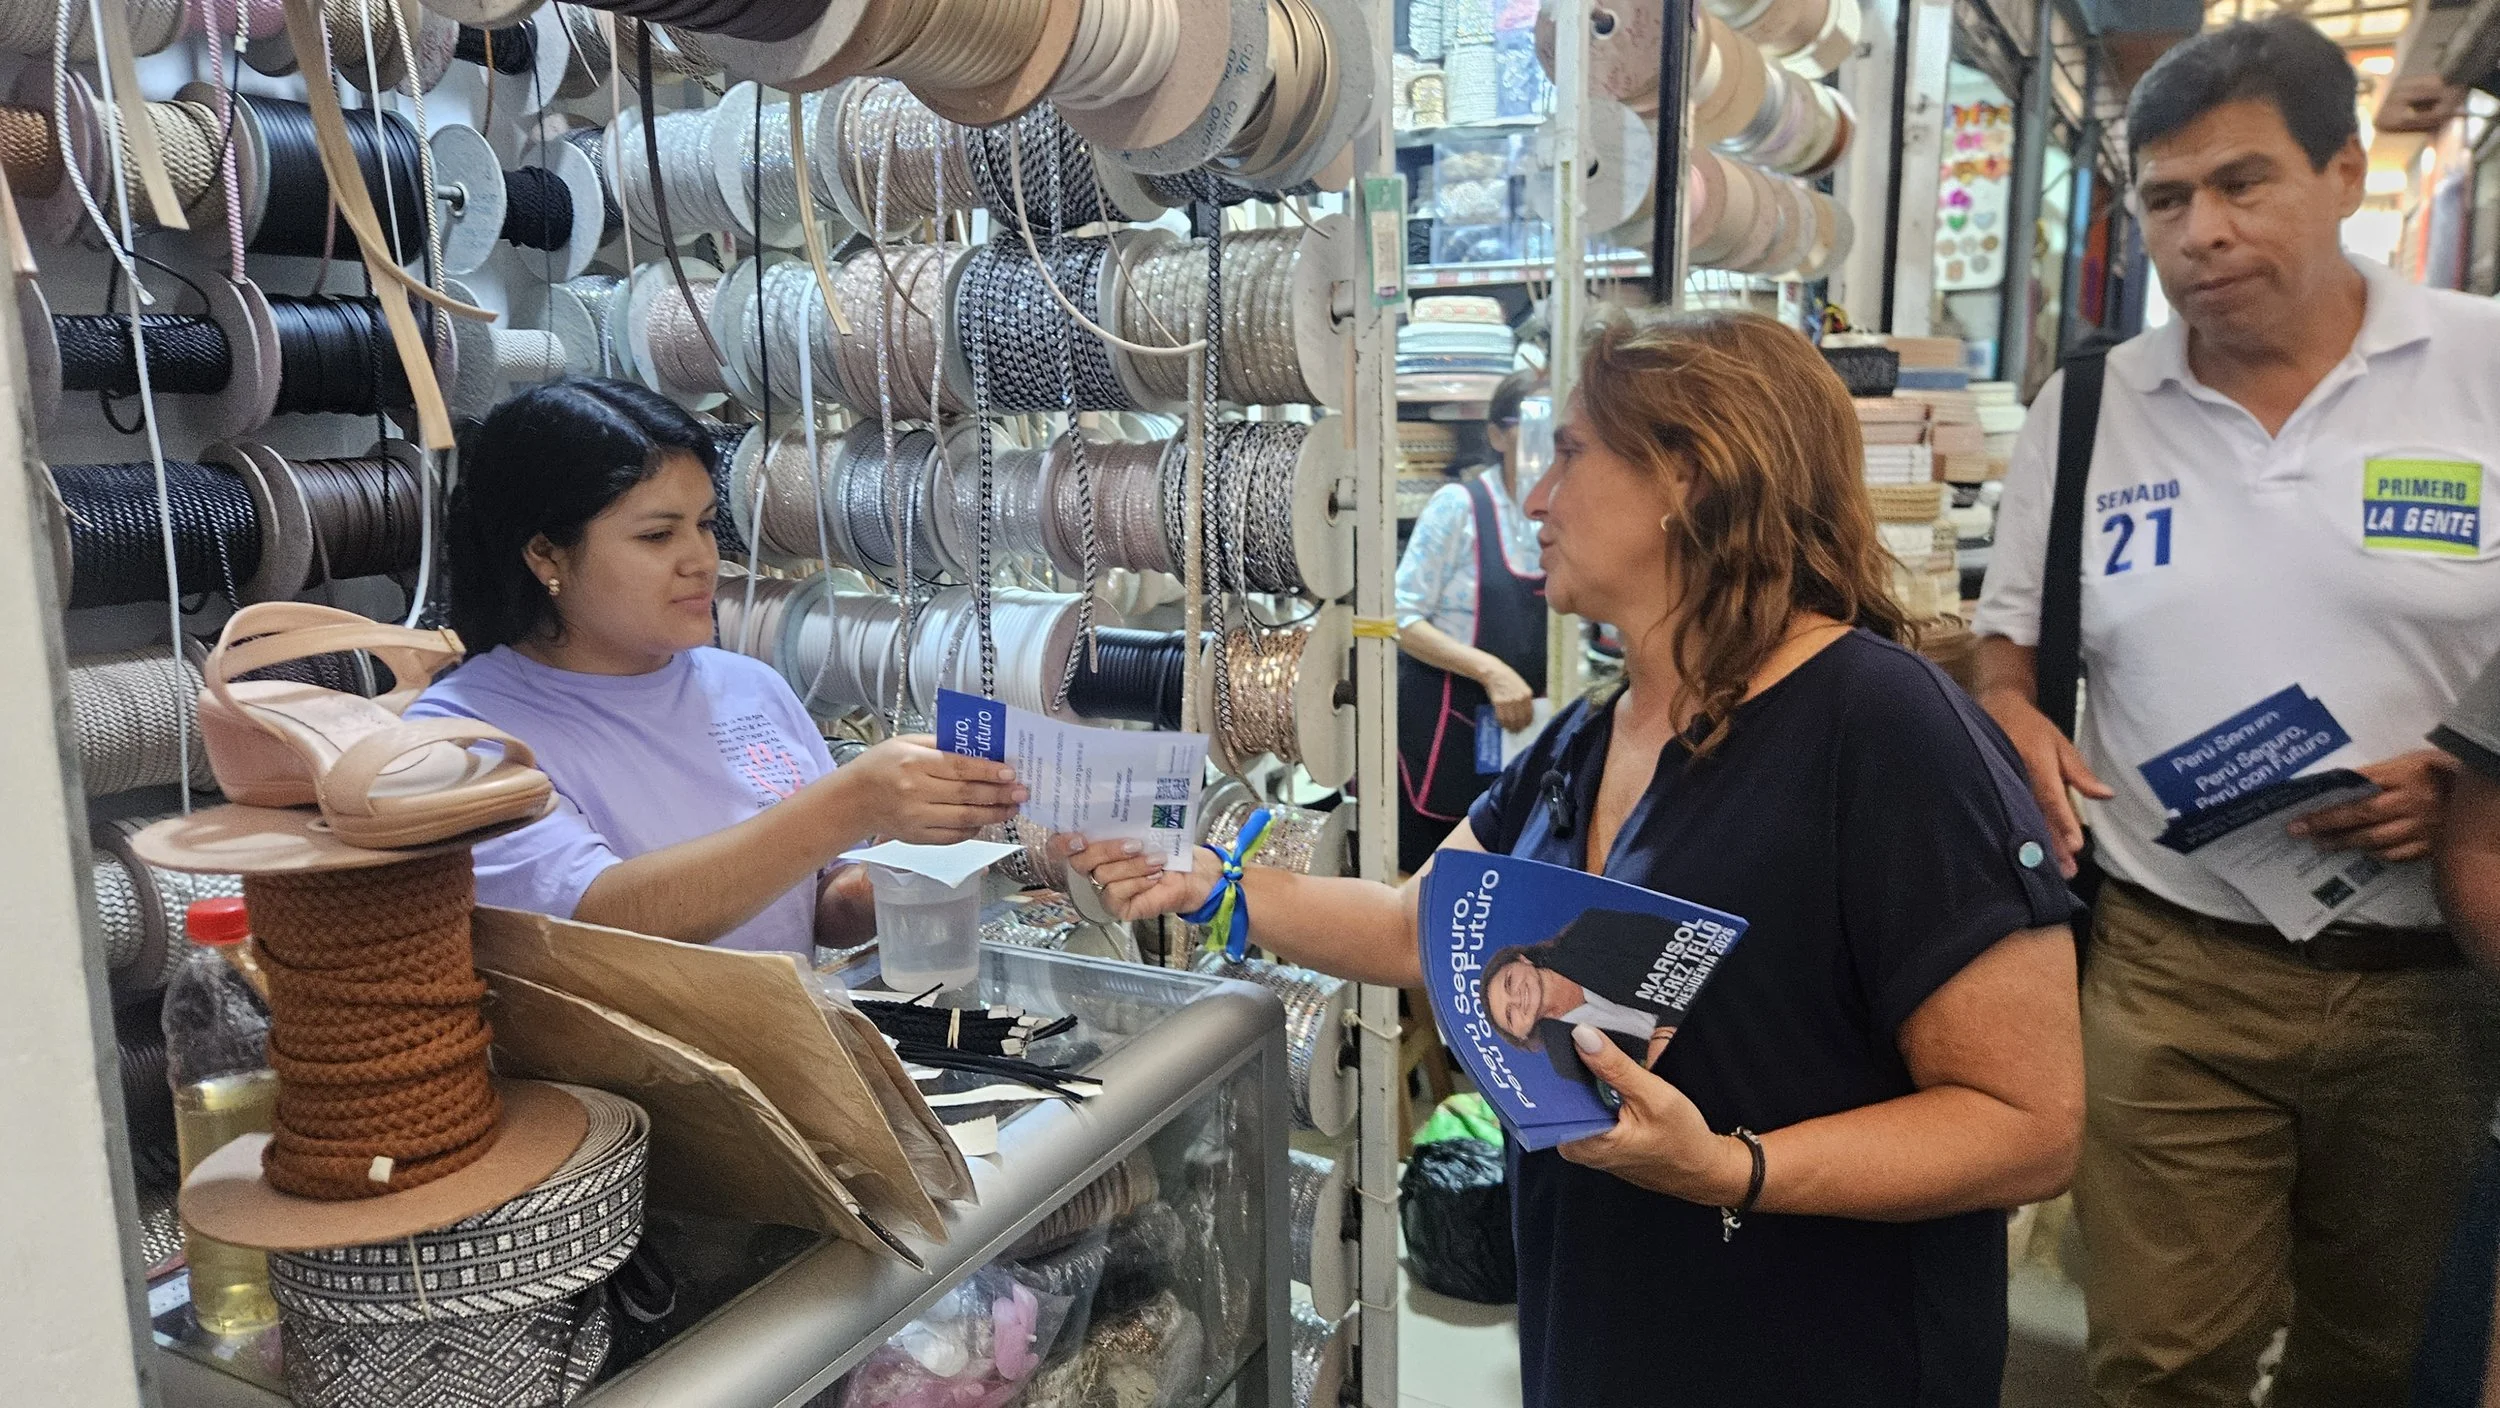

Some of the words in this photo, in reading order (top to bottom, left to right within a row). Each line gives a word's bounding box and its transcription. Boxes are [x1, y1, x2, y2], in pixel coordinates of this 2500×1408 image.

[2096, 478, 2181, 513] SENADO
[2366, 506, 2395, 532] LA
[2403, 506, 2477, 538] GENTE
[2377, 477, 2468, 502] PRIMERO
[2102, 507, 2173, 576] 21
[2194, 761, 2239, 793] Perú
[2238, 765, 2274, 791] con
[2270, 731, 2331, 772] Futuro
[1451, 891, 1476, 1015] Seguro,
[1463, 869, 1500, 972] Futuro
[1635, 918, 1703, 1000] MARISOL
[1652, 962, 1694, 1006] PEREZ
[1681, 920, 1722, 963] TELLO
[1671, 954, 1720, 1011] PRESIDENTA
[1709, 926, 1737, 956] 2026
[1470, 979, 1492, 1038] con
[1463, 1022, 1510, 1089] Perú
[1488, 1045, 1537, 1109] Perú
